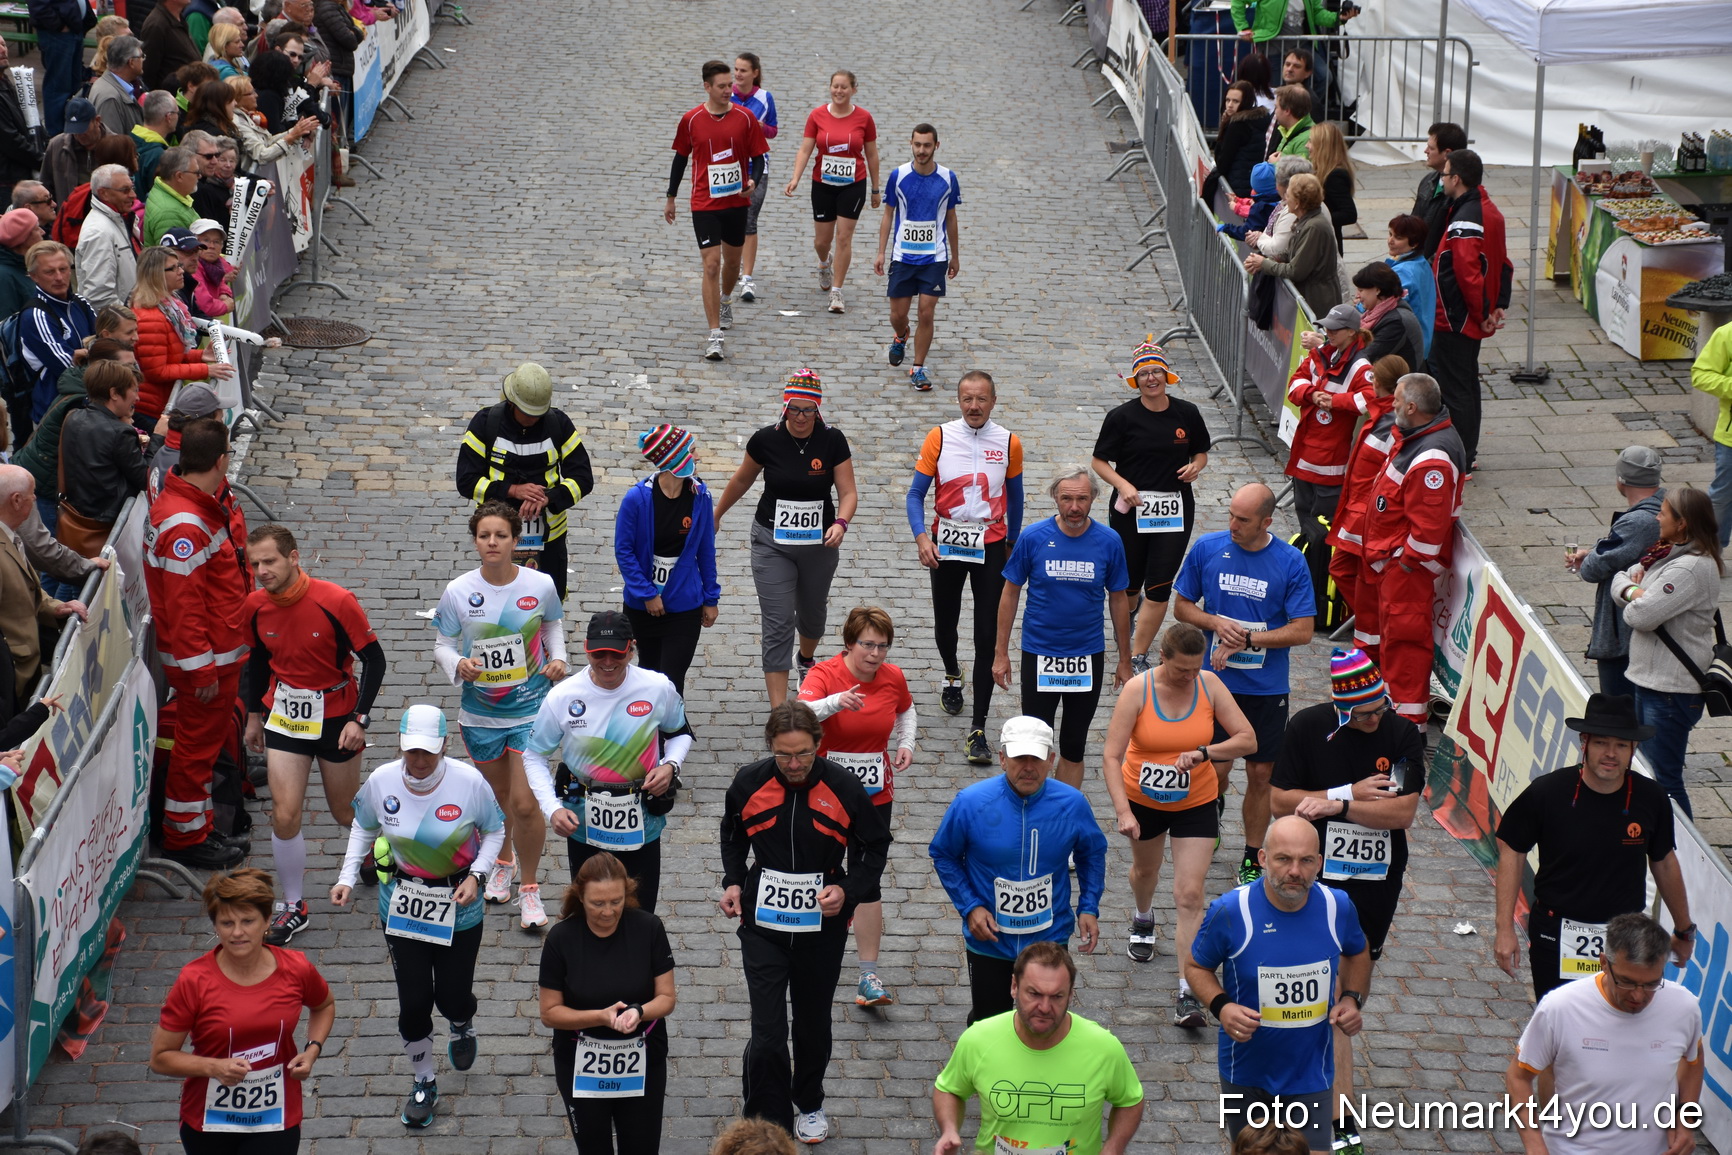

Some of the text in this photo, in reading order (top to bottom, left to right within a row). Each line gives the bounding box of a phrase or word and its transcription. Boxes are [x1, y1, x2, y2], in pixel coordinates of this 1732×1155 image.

[824, 162, 853, 177] 2430
[713, 170, 740, 186] 2123
[226, 183, 245, 256] BMW Laufsport
[247, 202, 262, 228] BMW
[904, 228, 934, 242] 3038
[1642, 321, 1698, 356] Lammsb
[1142, 500, 1179, 516] 2459
[780, 511, 819, 528] 2460
[1149, 519, 1170, 527] Sandra
[523, 519, 540, 534] 11
[786, 531, 812, 539] Stefanie
[942, 528, 980, 548] 2237
[1045, 559, 1095, 574] HUBER
[1219, 573, 1268, 592] HUBER
[1229, 585, 1265, 598] TECHNOLOGY
[486, 640, 514, 650] Neumarkt
[480, 648, 516, 669] 184
[1043, 656, 1088, 674] 2566
[486, 672, 512, 683] Sophie
[1048, 677, 1082, 686] Wolfgang
[281, 698, 313, 720] 130
[630, 705, 650, 713] Hervis
[279, 719, 310, 732] Christian
[828, 755, 848, 764] PARTL
[1140, 767, 1190, 789] 2220
[587, 796, 633, 808] PARTL Neumarkt
[1154, 792, 1172, 800] Gabi
[439, 809, 459, 817] Hervis
[591, 806, 639, 830] 3026
[595, 831, 625, 843] Heinrich
[1328, 826, 1381, 837] PARTL Neumarkt
[1332, 836, 1387, 862] 2458
[762, 874, 813, 886] PARTL Neumarkt
[396, 884, 447, 899] PARTL Neumarkt
[995, 881, 1043, 893] PARTL Neumarkt
[763, 884, 818, 910] 2563
[999, 888, 1048, 914] 2285
[396, 894, 452, 923] 3027
[776, 913, 801, 924] Klaus
[1009, 916, 1040, 927] Helmut
[405, 919, 429, 932] Helga
[1563, 923, 1587, 935] PARTL
[1576, 935, 1605, 958] 23
[1577, 961, 1604, 972] Matth
[1260, 969, 1320, 980] PARTL Neumarkt
[1275, 979, 1319, 1005] 380
[1282, 1010, 1313, 1020] Martin
[579, 1040, 635, 1051] PARTL Neumarkt
[582, 1051, 641, 1075] 2562
[598, 1079, 622, 1091] Gaby
[214, 1081, 279, 1110] 2625
[226, 1113, 263, 1124] Monika
